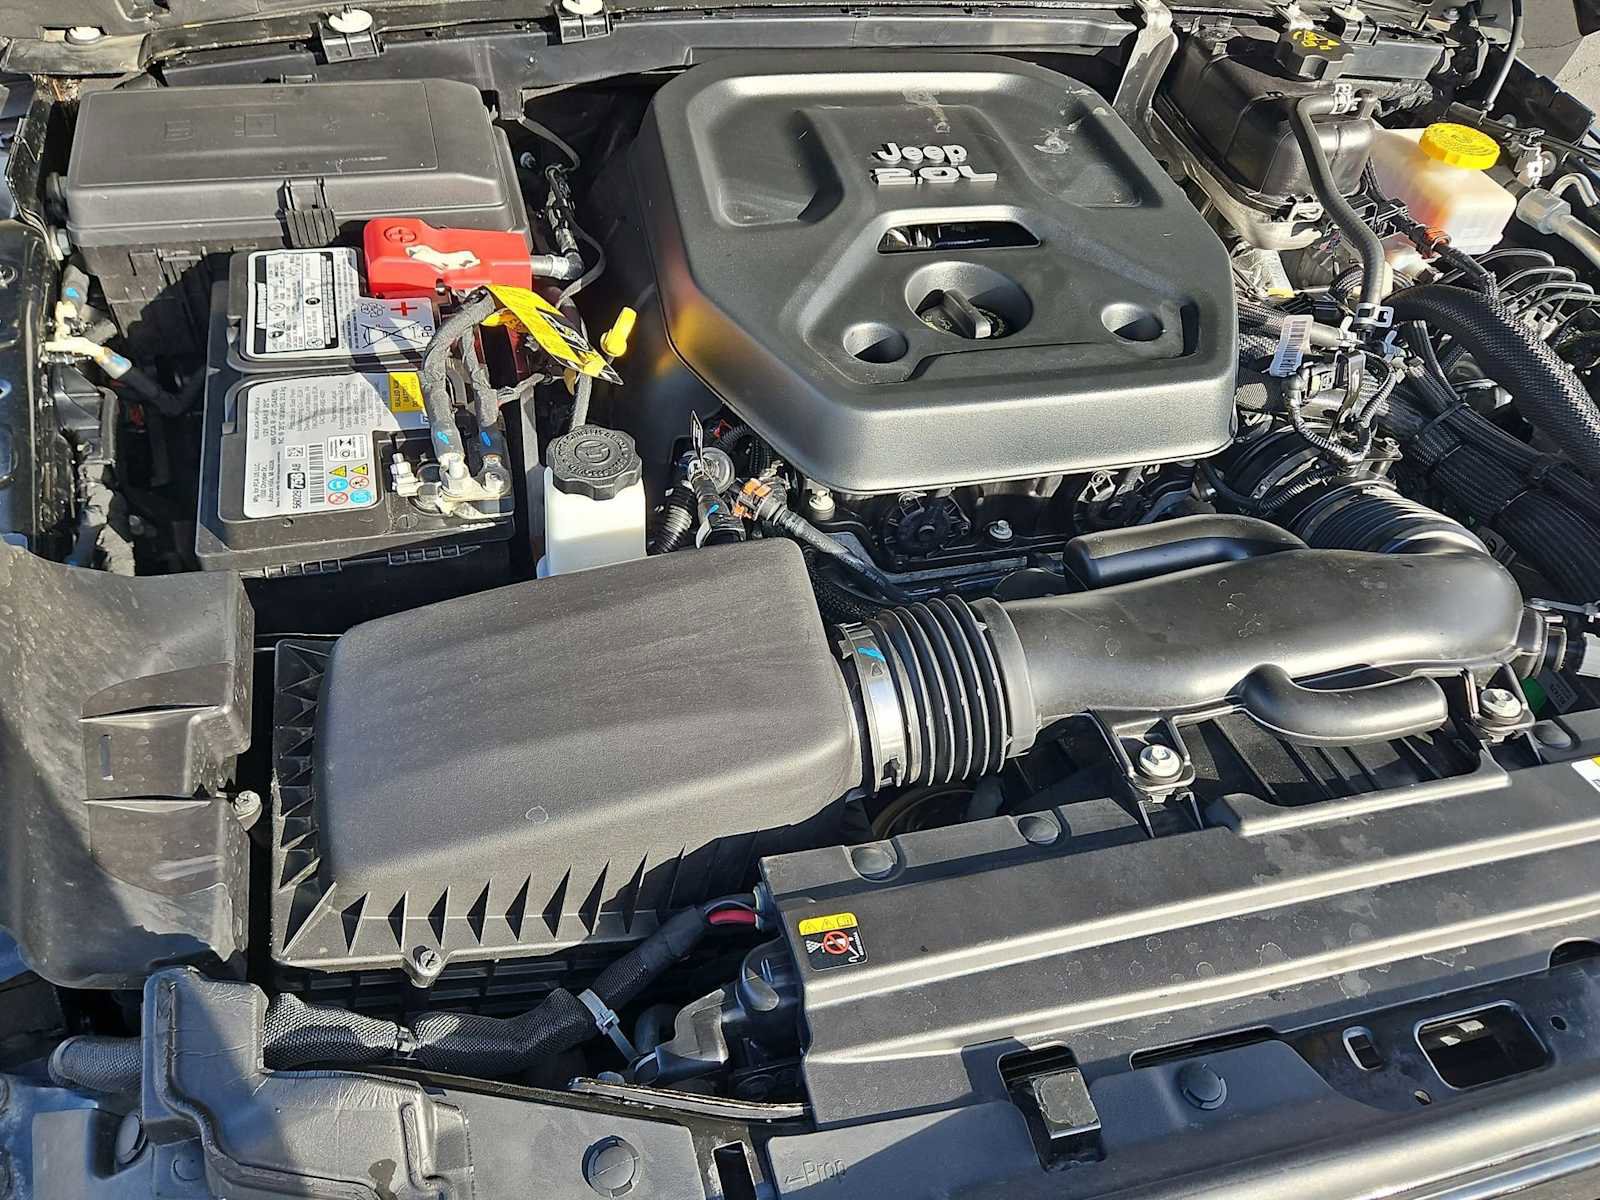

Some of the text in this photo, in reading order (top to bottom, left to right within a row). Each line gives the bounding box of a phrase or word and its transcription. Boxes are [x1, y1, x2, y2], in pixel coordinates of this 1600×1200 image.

[877, 142, 967, 165] Jeep
[875, 165, 997, 186] 2.0L
[422, 325, 432, 337] Pb
[290, 473, 304, 488] 758
[803, 1159, 847, 1184] Prop
